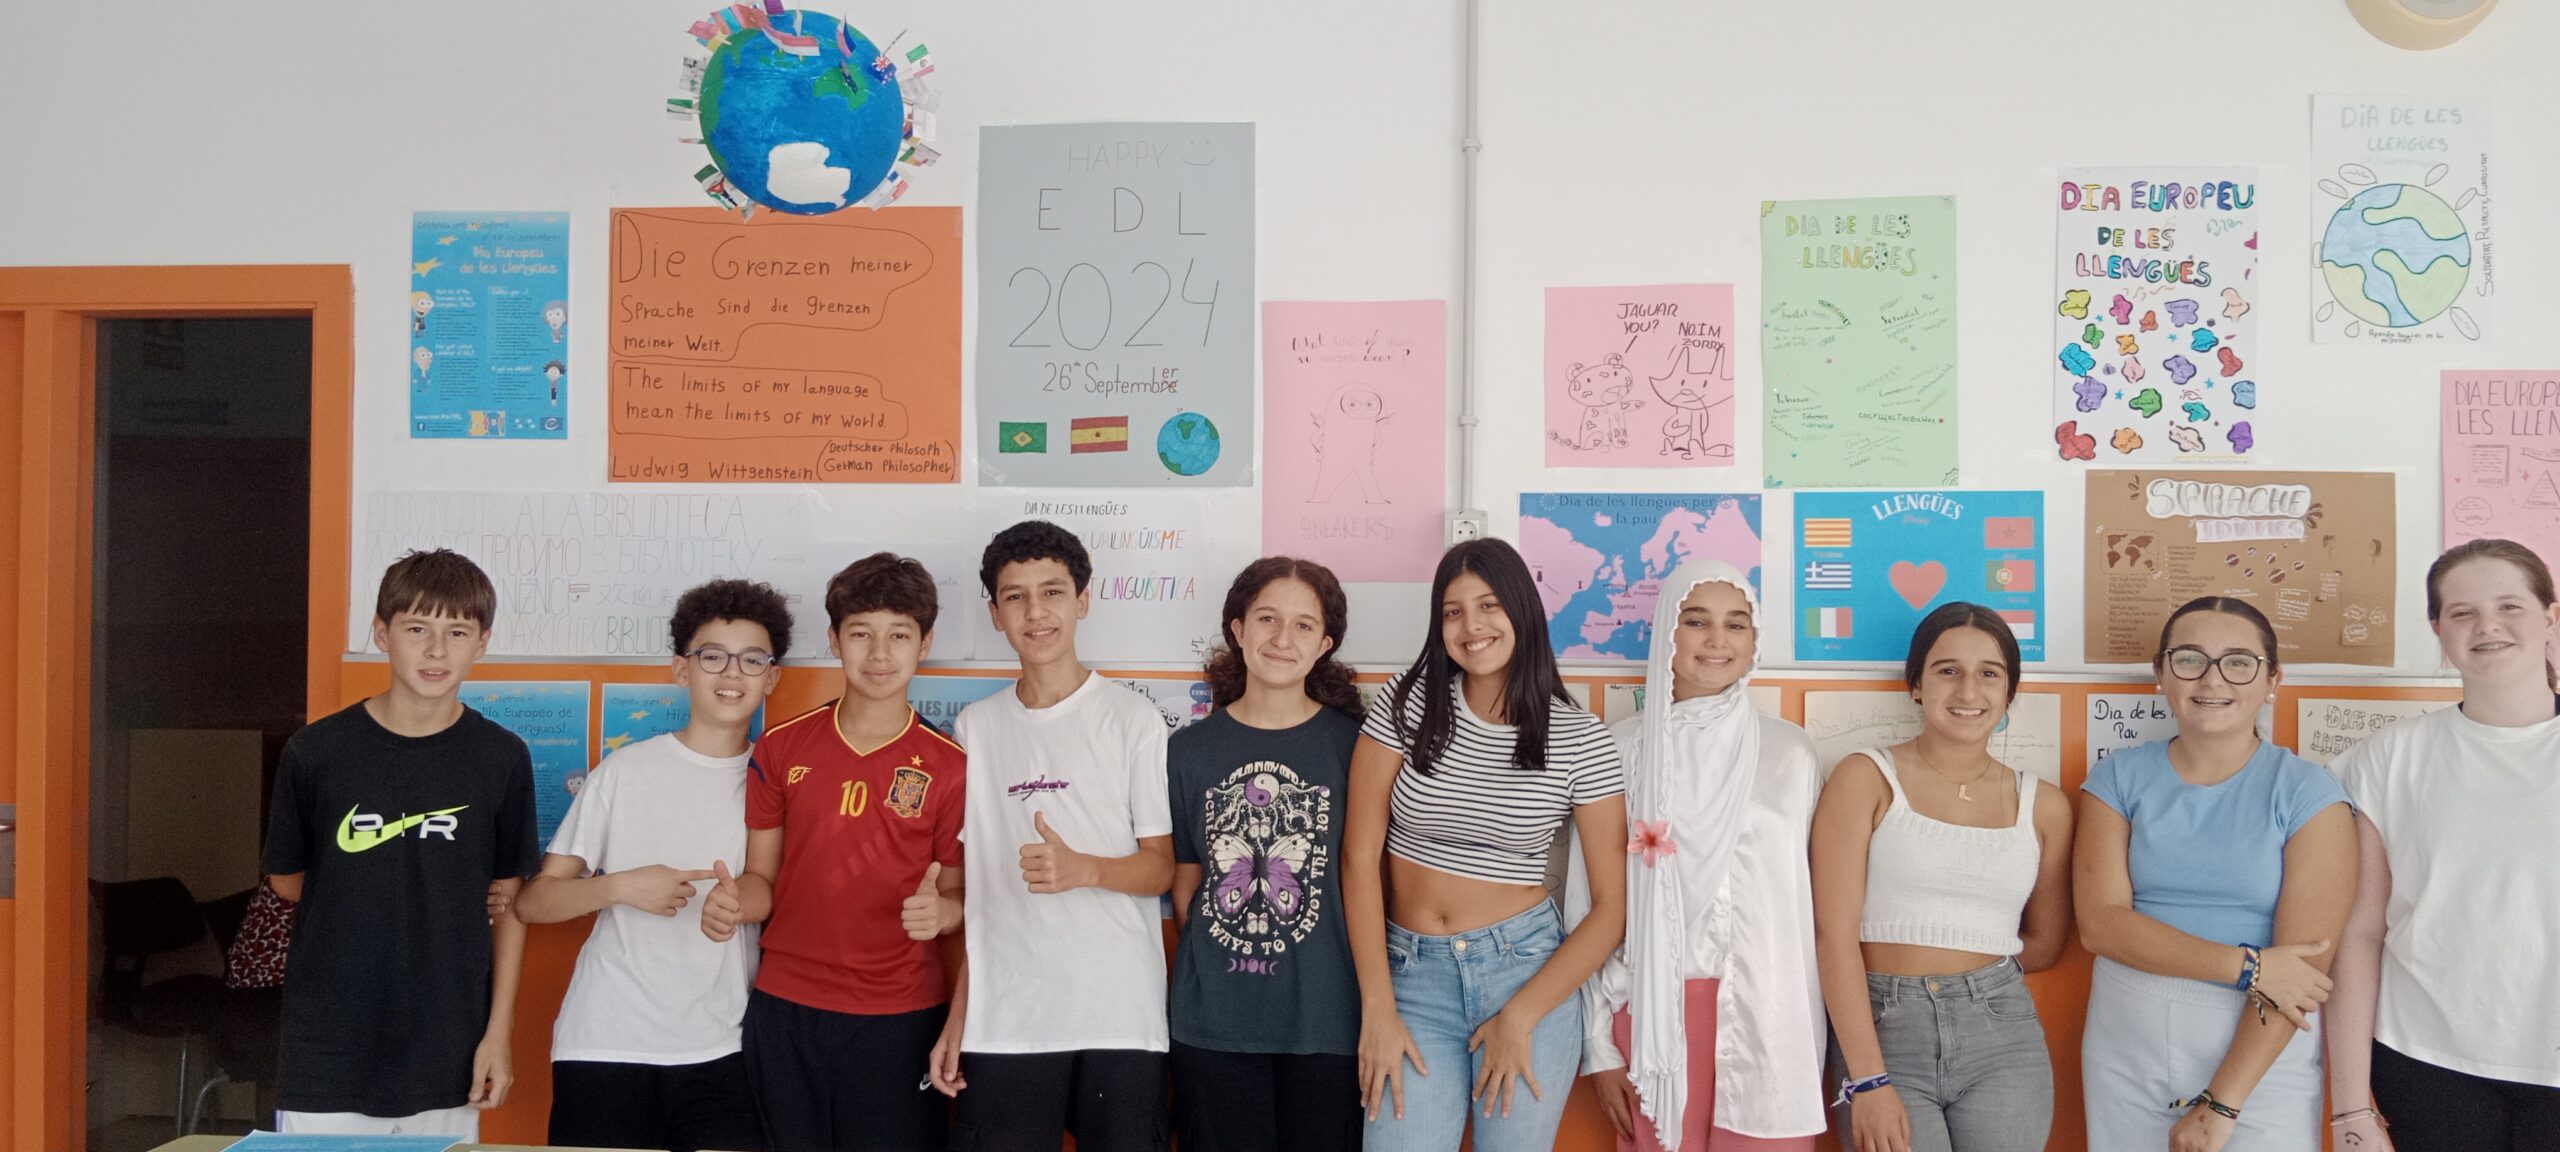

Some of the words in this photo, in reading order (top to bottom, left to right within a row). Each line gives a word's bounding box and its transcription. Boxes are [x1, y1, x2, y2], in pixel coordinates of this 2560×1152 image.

[2390, 106, 2414, 126] DE
[2424, 107, 2463, 126] LES
[1067, 141, 1169, 173] HAPPY
[2061, 181, 2121, 211] DIA
[2130, 181, 2256, 213] EUROPEU
[1785, 214, 1822, 237] DIA
[1835, 215, 1857, 235] DE
[1871, 213, 1912, 239] LES
[2097, 226, 2125, 248] DE
[2134, 227, 2176, 252] LES
[496, 246, 544, 261] Europeu
[618, 213, 687, 284] Die
[712, 236, 831, 280] Grenzen
[850, 256, 914, 273] meiner
[459, 262, 474, 274] de
[479, 262, 498, 274] les
[770, 297, 789, 314] die
[1008, 256, 1220, 352] 2024
[1616, 301, 1679, 319] JAGUAR
[1623, 319, 1660, 336] YOU?
[624, 335, 675, 351] meiner
[622, 366, 664, 391] The
[680, 371, 727, 394] limits
[803, 375, 870, 398] language
[2454, 380, 2483, 406] DIA
[626, 400, 675, 419] mean
[686, 402, 713, 421] the
[725, 402, 771, 423] limits
[2457, 408, 2494, 436] LES
[611, 460, 690, 479] Ludwig
[707, 461, 815, 481] Wittgenstein
[824, 458, 873, 473] German
[1559, 495, 1581, 508] Dia
[1586, 494, 1601, 508] de
[1606, 494, 1626, 508] les
[1692, 496, 1715, 510] per
[1871, 492, 1965, 521] LLENGÜES
[2148, 479, 2308, 517] SPRACHE
[542, 493, 584, 538] LA
[593, 493, 747, 539] BIBLIOTECA
[1299, 516, 1394, 541] SNEAKERS
[1616, 513, 1624, 525] la
[1631, 515, 1657, 527] pau
[481, 534, 582, 577] ПРОСИМО
[504, 707, 554, 722] Europeo
[558, 706, 573, 719] de
[2094, 699, 2125, 720] Dia
[2130, 699, 2146, 720] de
[2150, 700, 2167, 720] les
[839, 779, 869, 818] 10
[350, 812, 460, 841] AIR
[1260, 938, 1287, 956] TO
[1290, 885, 1323, 944] ENJOY
[1310, 844, 1329, 880] THE
